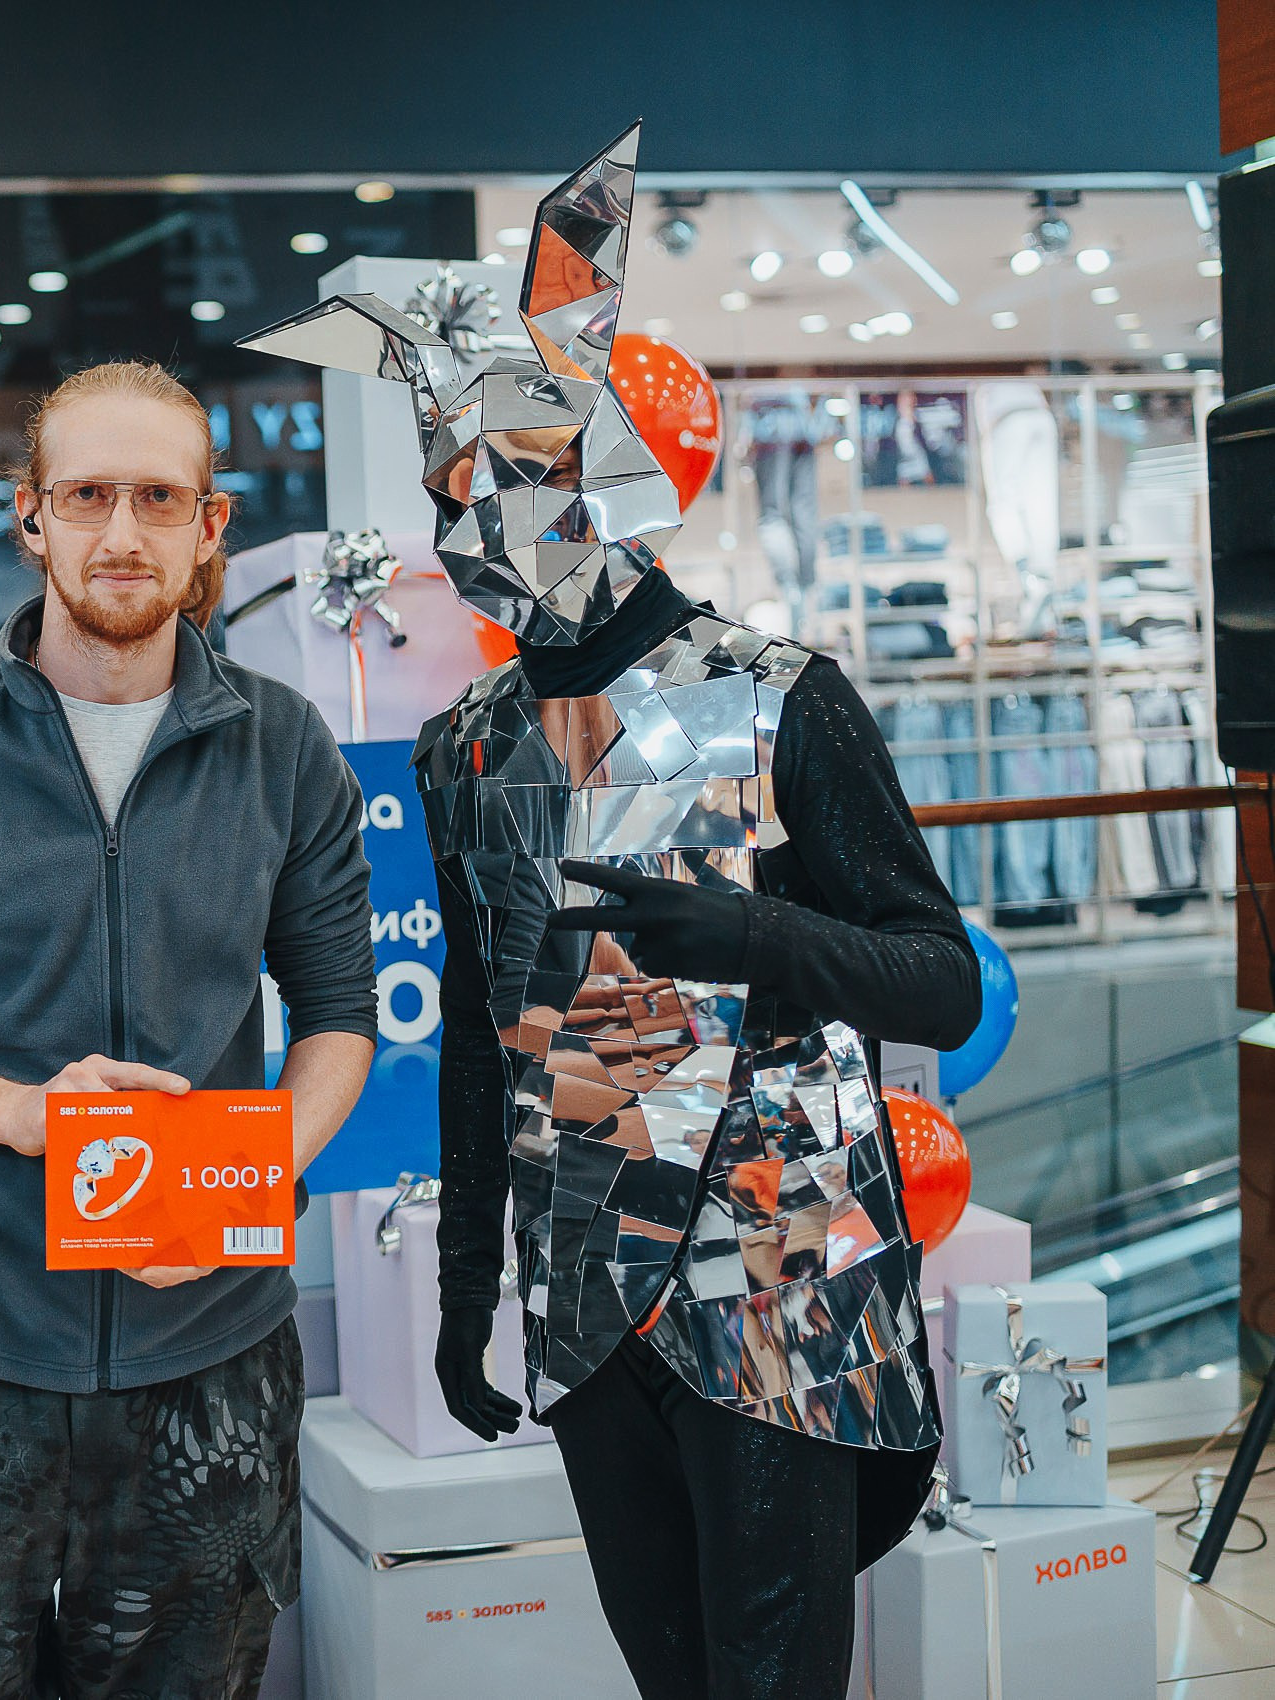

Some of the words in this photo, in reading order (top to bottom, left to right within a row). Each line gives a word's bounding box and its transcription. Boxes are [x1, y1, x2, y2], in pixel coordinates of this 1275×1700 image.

[59, 1106, 77, 1116] 585
[87, 1105, 134, 1115] ЗОЛОТОЙ
[227, 1105, 282, 1113] СЕРТИФИКАТ
[426, 1609, 453, 1623] 585
[471, 1598, 546, 1619] ЗОЛОТОЙ
